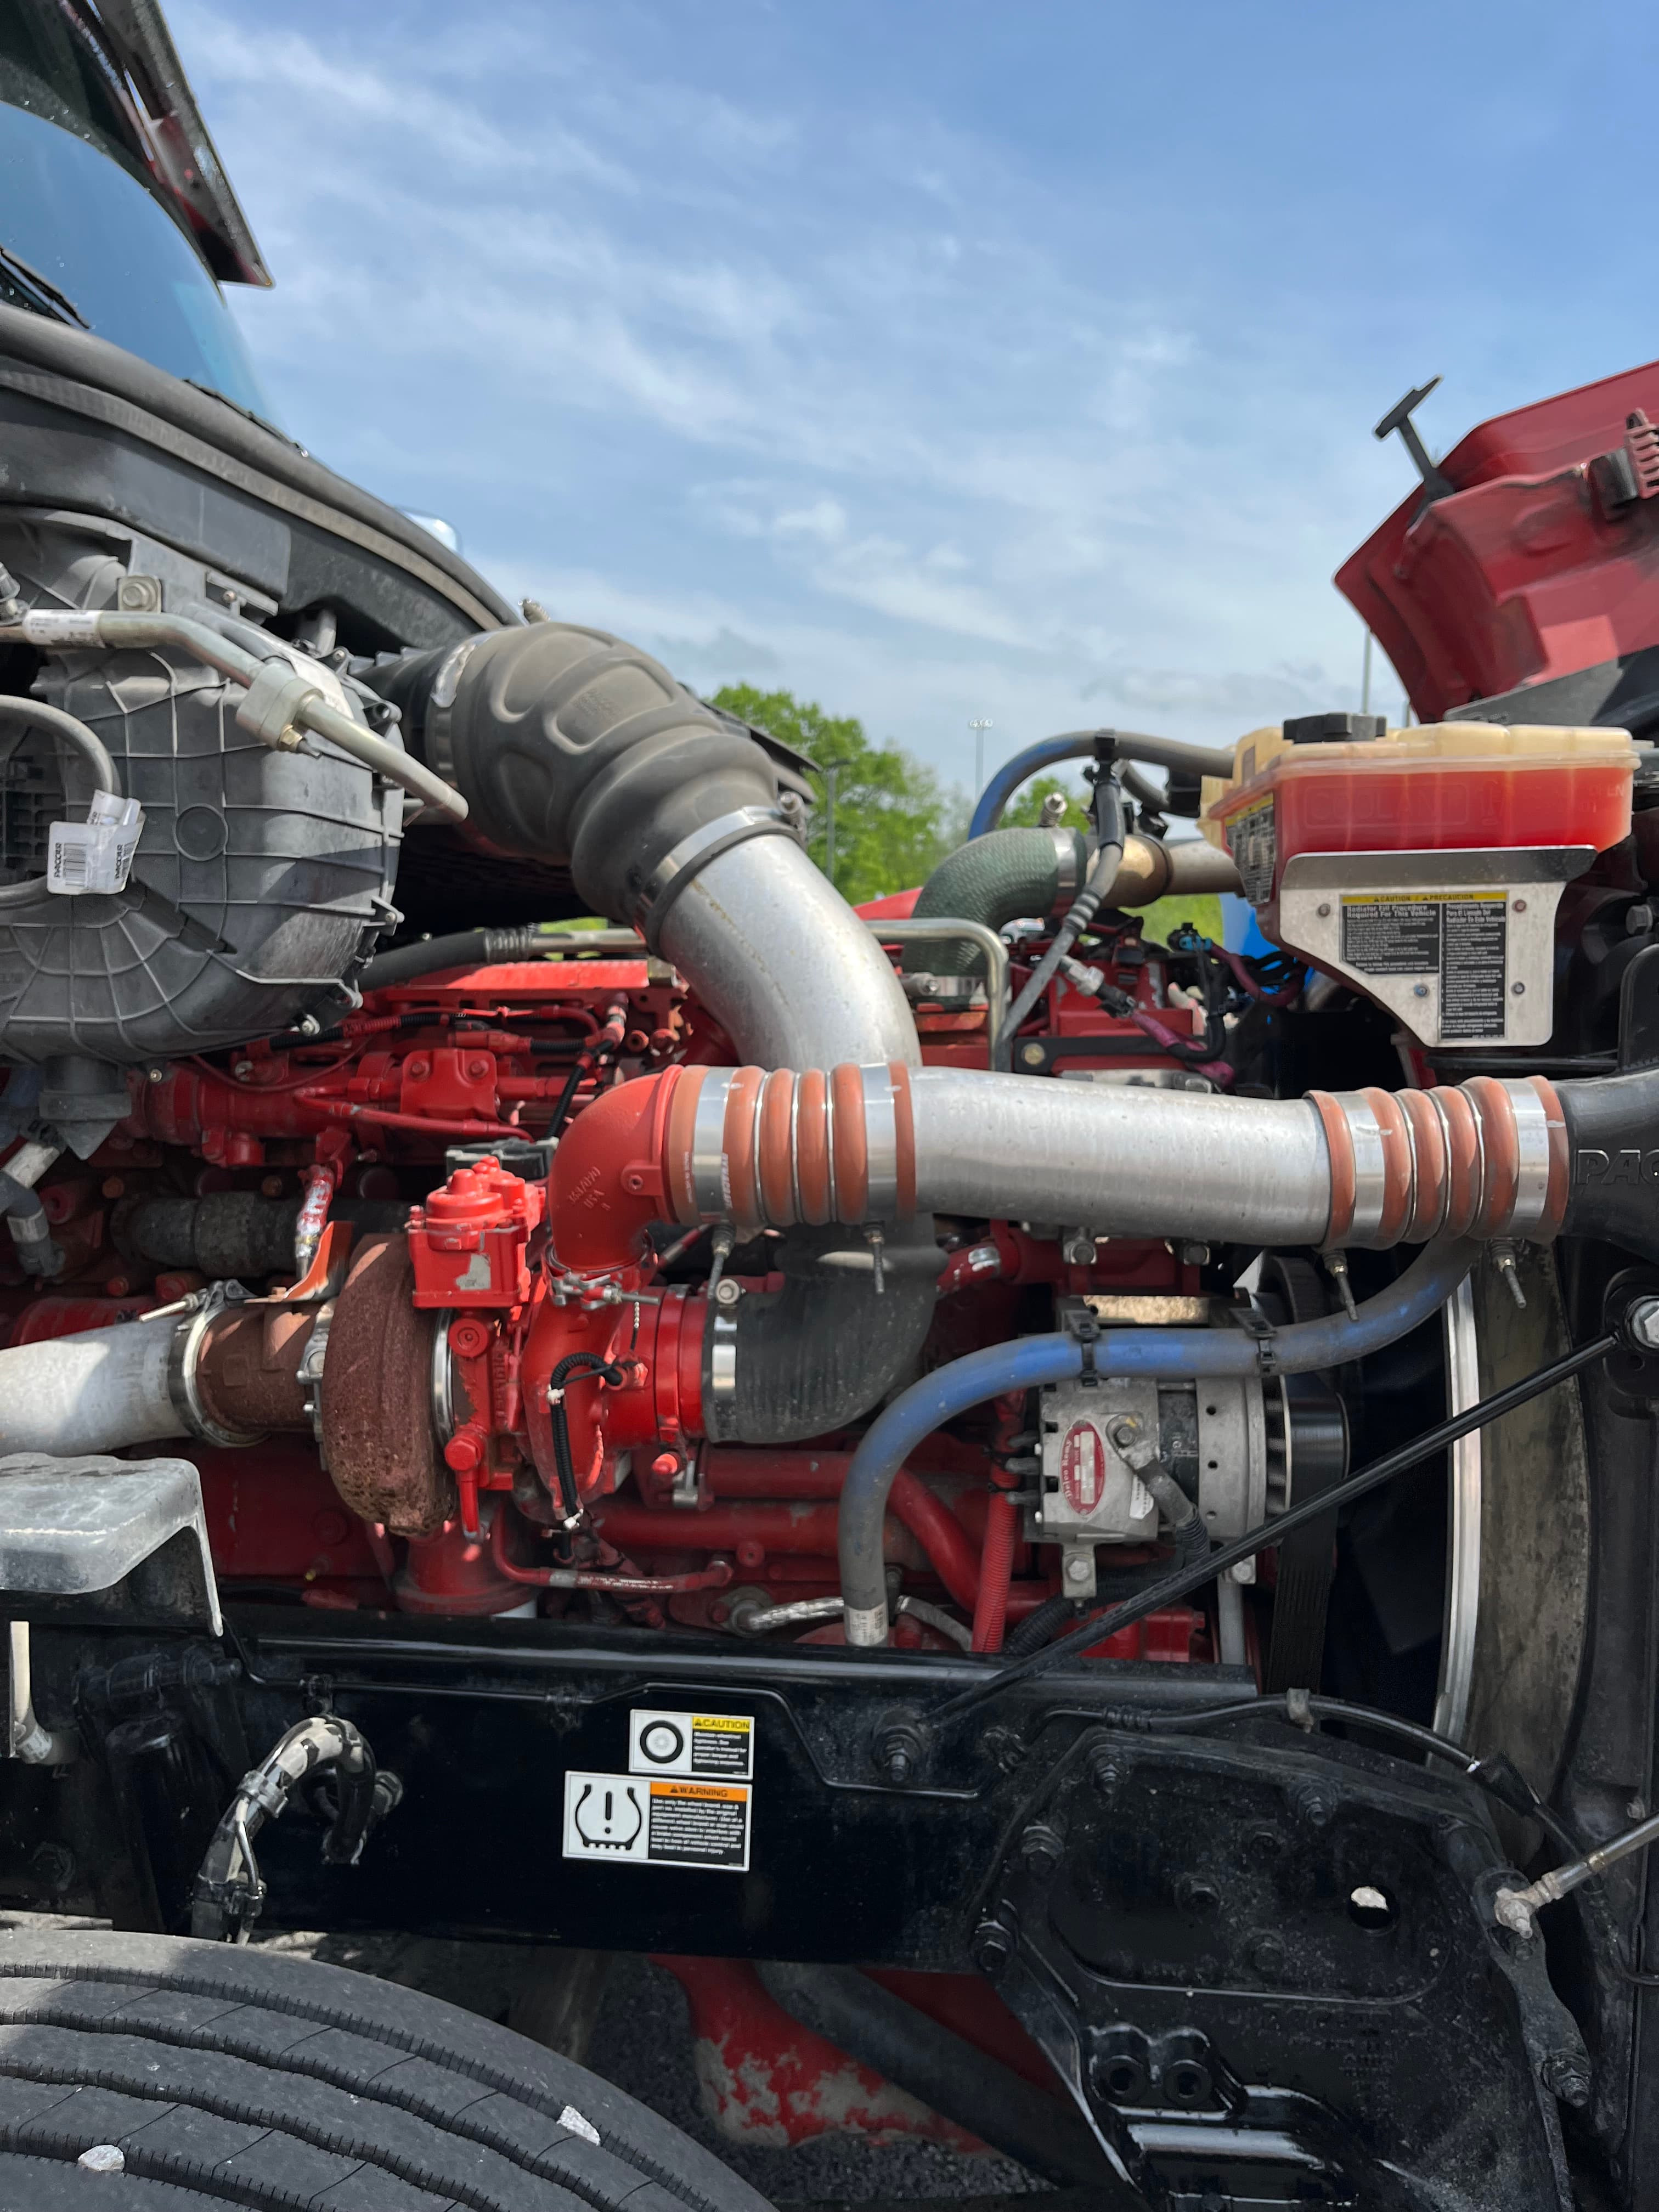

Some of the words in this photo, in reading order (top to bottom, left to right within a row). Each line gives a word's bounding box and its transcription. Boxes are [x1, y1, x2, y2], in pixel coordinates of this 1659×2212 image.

[1379, 894, 1410, 902] CAUTION
[1347, 905, 1378, 913] Radiator
[1347, 911, 1378, 919] Required
[1062, 1439, 1073, 1466] Remy
[1063, 1469, 1073, 1499] Delco
[703, 1718, 750, 1730] CAUTION
[680, 1786, 729, 1798] WARNING
